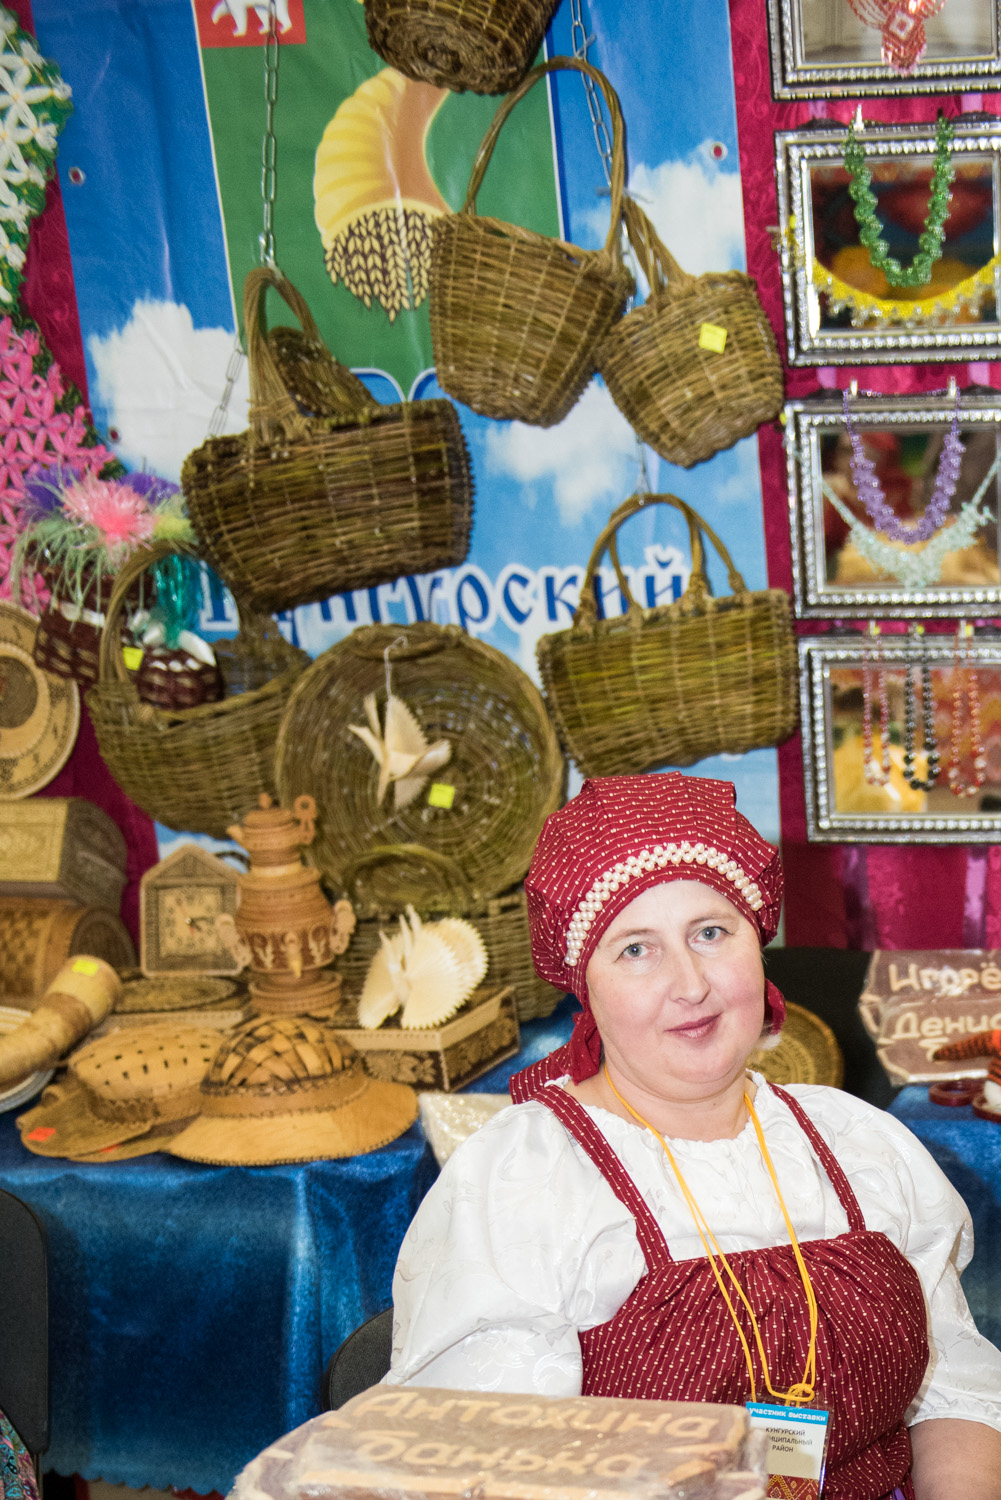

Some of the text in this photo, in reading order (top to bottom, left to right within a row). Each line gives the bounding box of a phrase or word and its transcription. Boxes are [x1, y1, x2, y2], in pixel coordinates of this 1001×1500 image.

[352, 1391, 720, 1440] Антохина
[749, 1407, 826, 1422] участник выставки
[765, 1426, 806, 1436] КУНГУРСКИЙ
[768, 1435, 813, 1446] ИЦИПАЛЬНЫЙ
[352, 1429, 650, 1478] банька
[772, 1445, 794, 1453] РАЙОН
